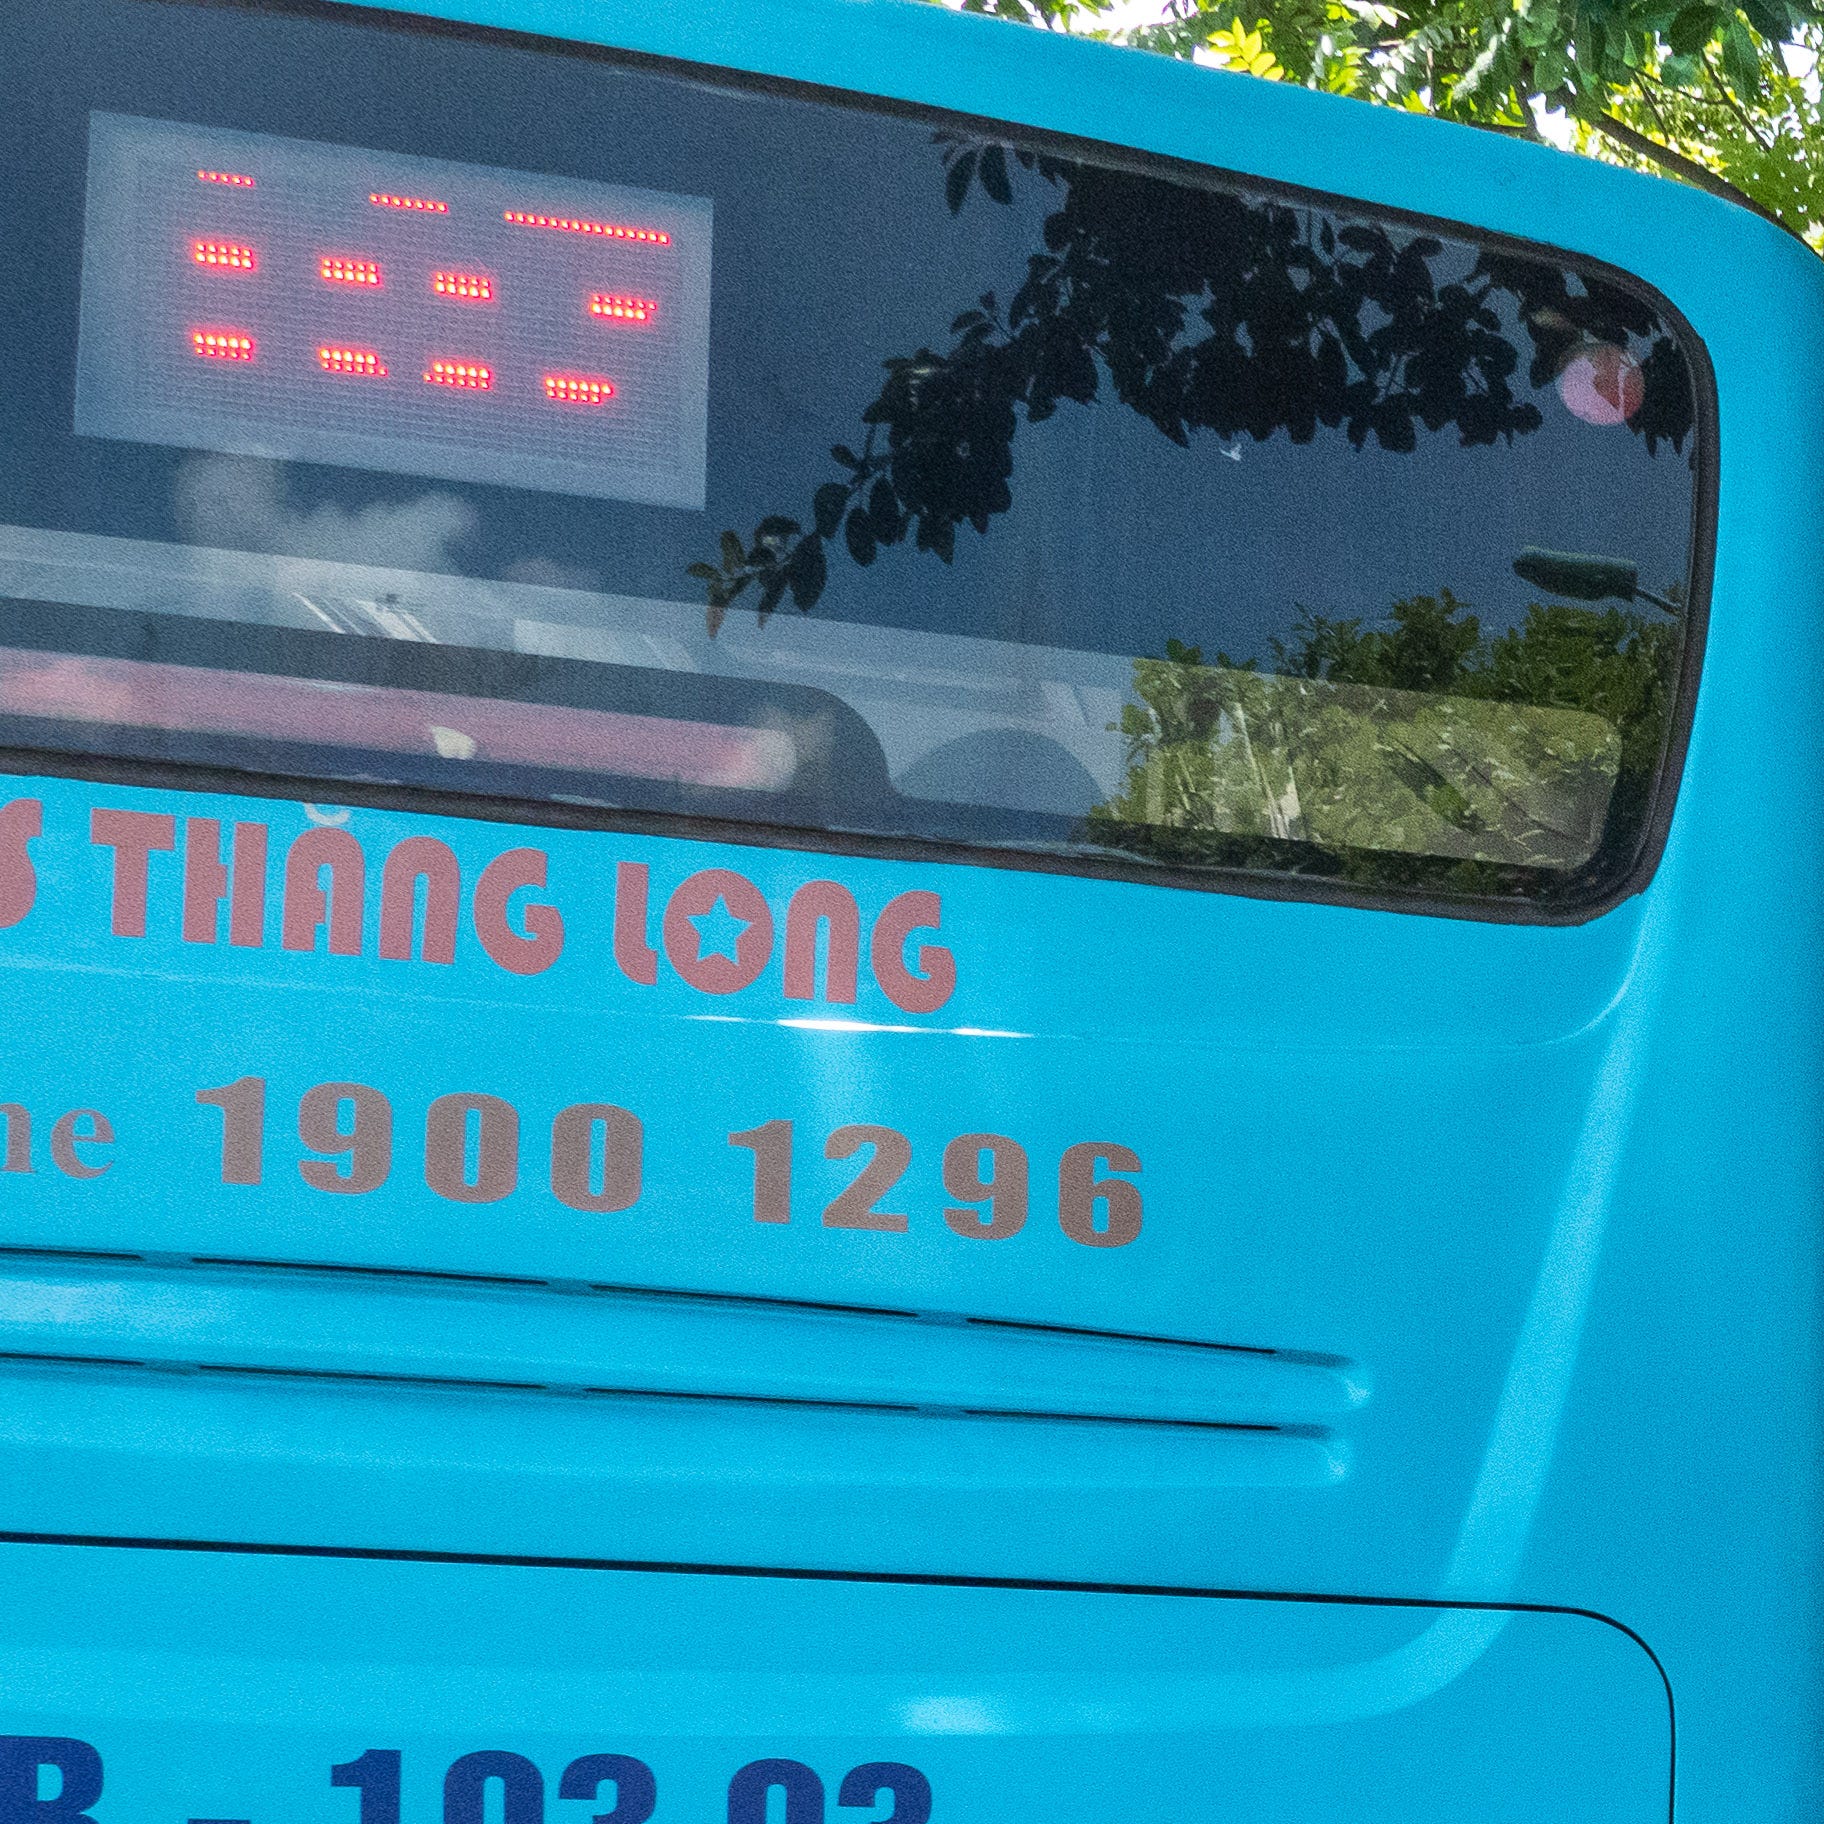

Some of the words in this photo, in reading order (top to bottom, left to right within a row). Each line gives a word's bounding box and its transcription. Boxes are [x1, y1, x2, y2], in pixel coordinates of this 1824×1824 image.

[91, 802, 564, 977] THĂNG
[614, 862, 957, 1014] LONG
[195, 1076, 644, 1212] 1900
[729, 1118, 1145, 1248] 1296
